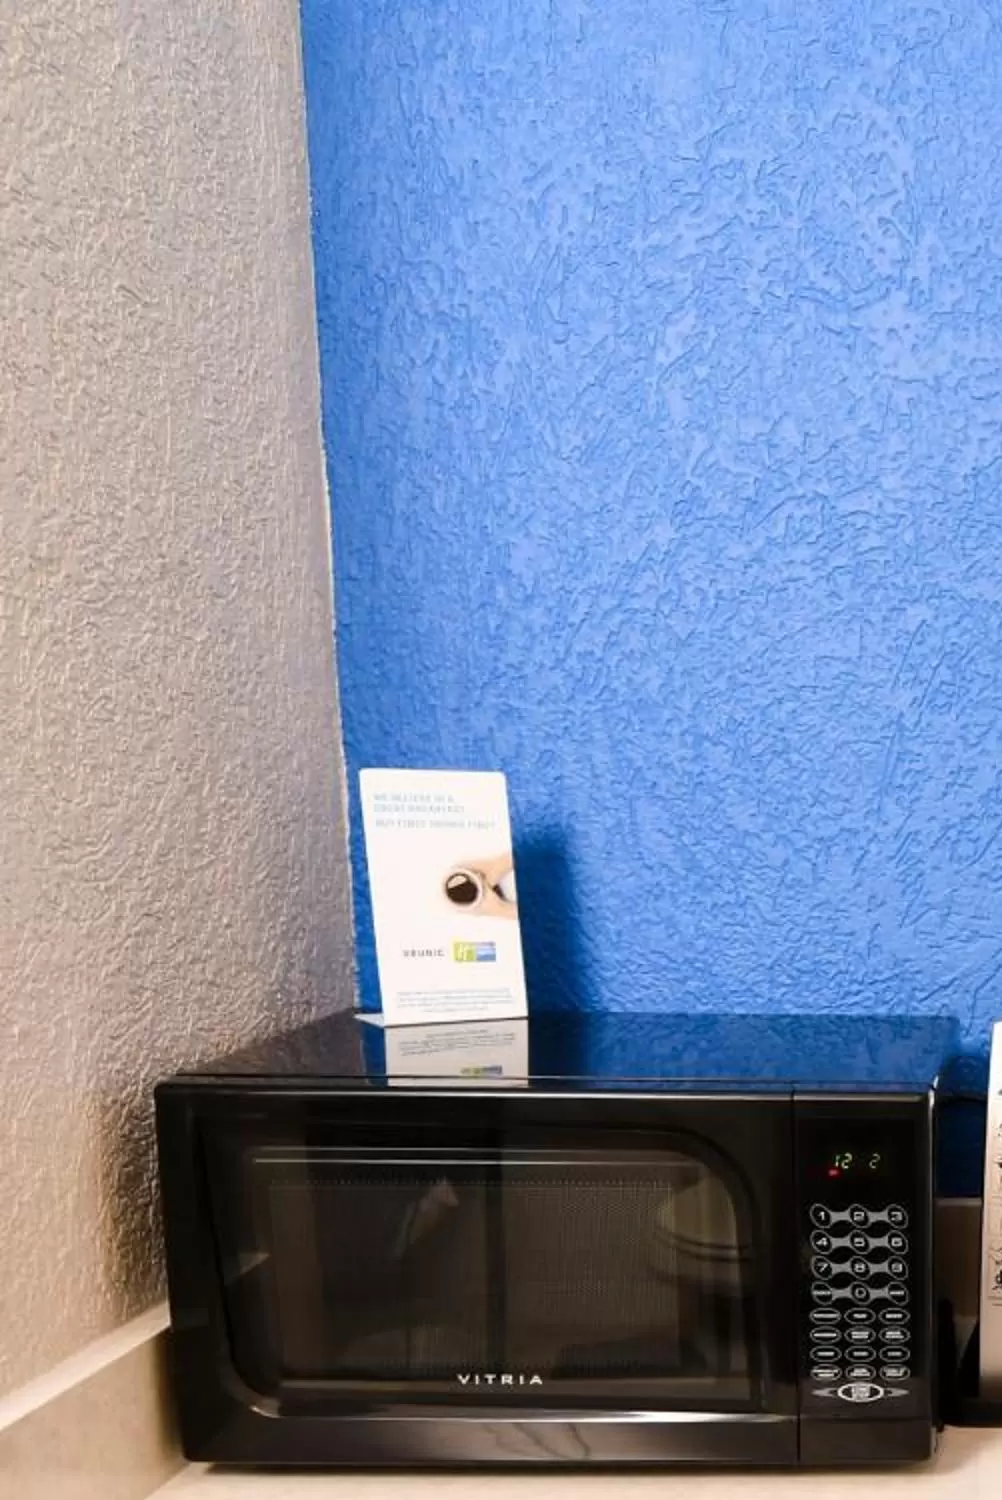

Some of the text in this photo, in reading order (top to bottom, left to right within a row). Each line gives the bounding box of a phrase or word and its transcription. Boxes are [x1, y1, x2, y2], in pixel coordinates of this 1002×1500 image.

[816, 1237, 828, 1247] 4
[817, 1262, 829, 1273] 7
[854, 1287, 867, 1299] 0
[456, 1373, 543, 1385] VITRIA
